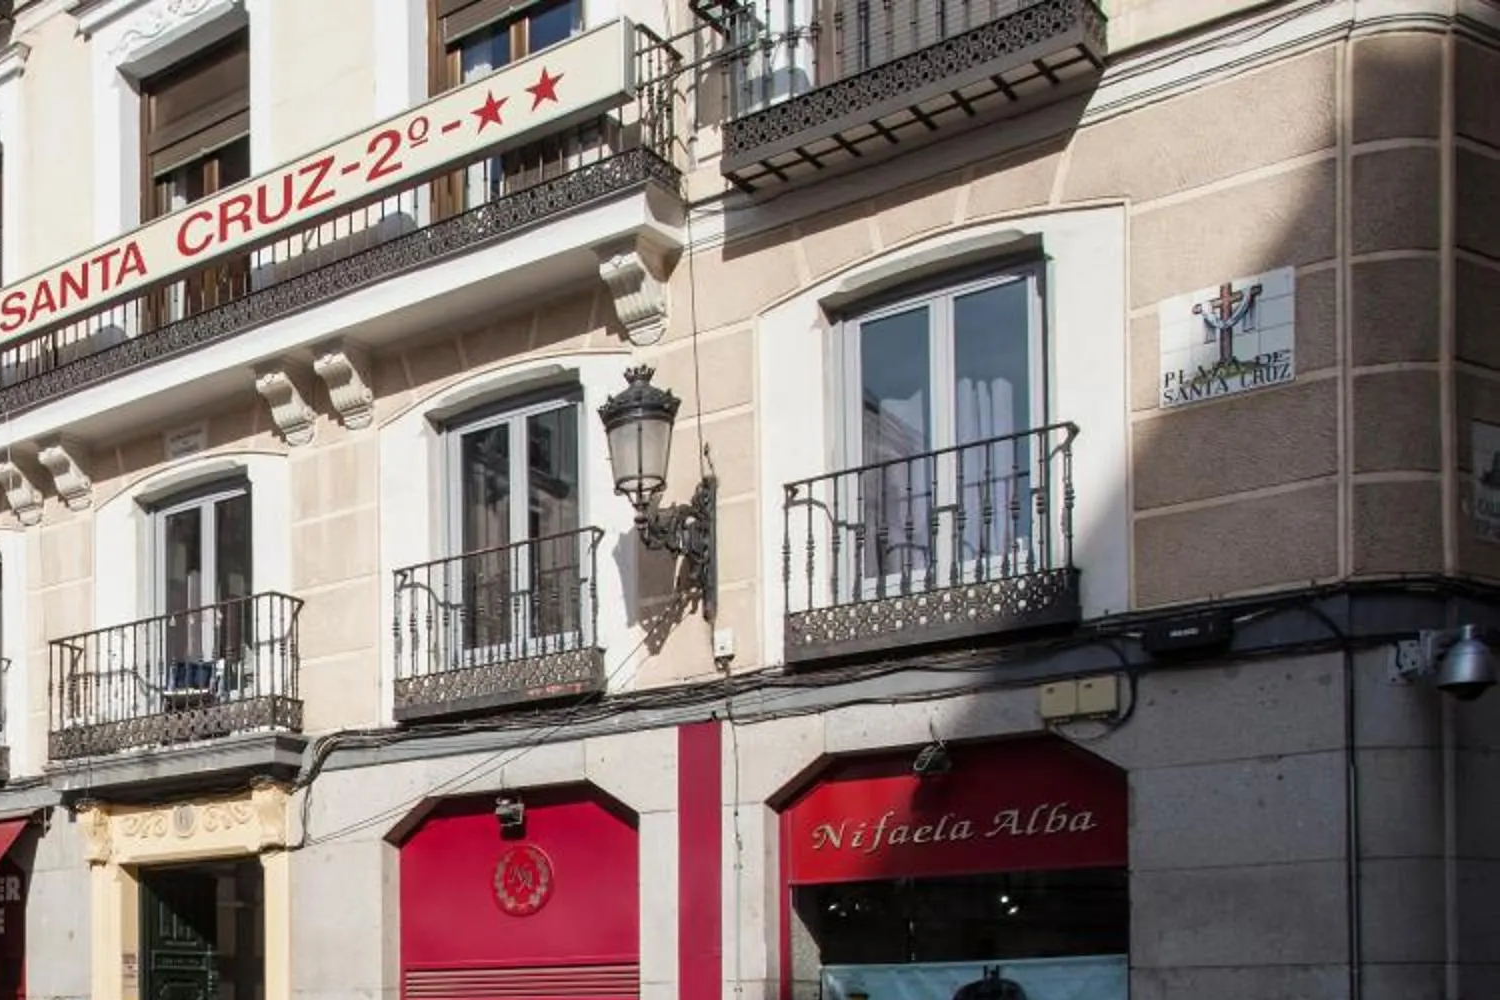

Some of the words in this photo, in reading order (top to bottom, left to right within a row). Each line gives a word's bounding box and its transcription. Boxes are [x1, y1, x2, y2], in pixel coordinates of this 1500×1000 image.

[1163, 355, 1240, 390] PLAZA
[1163, 377, 1229, 404] SANTA
[1241, 362, 1291, 389] CRUZ
[811, 809, 975, 854] Nifaela
[985, 801, 1098, 837] Alba
